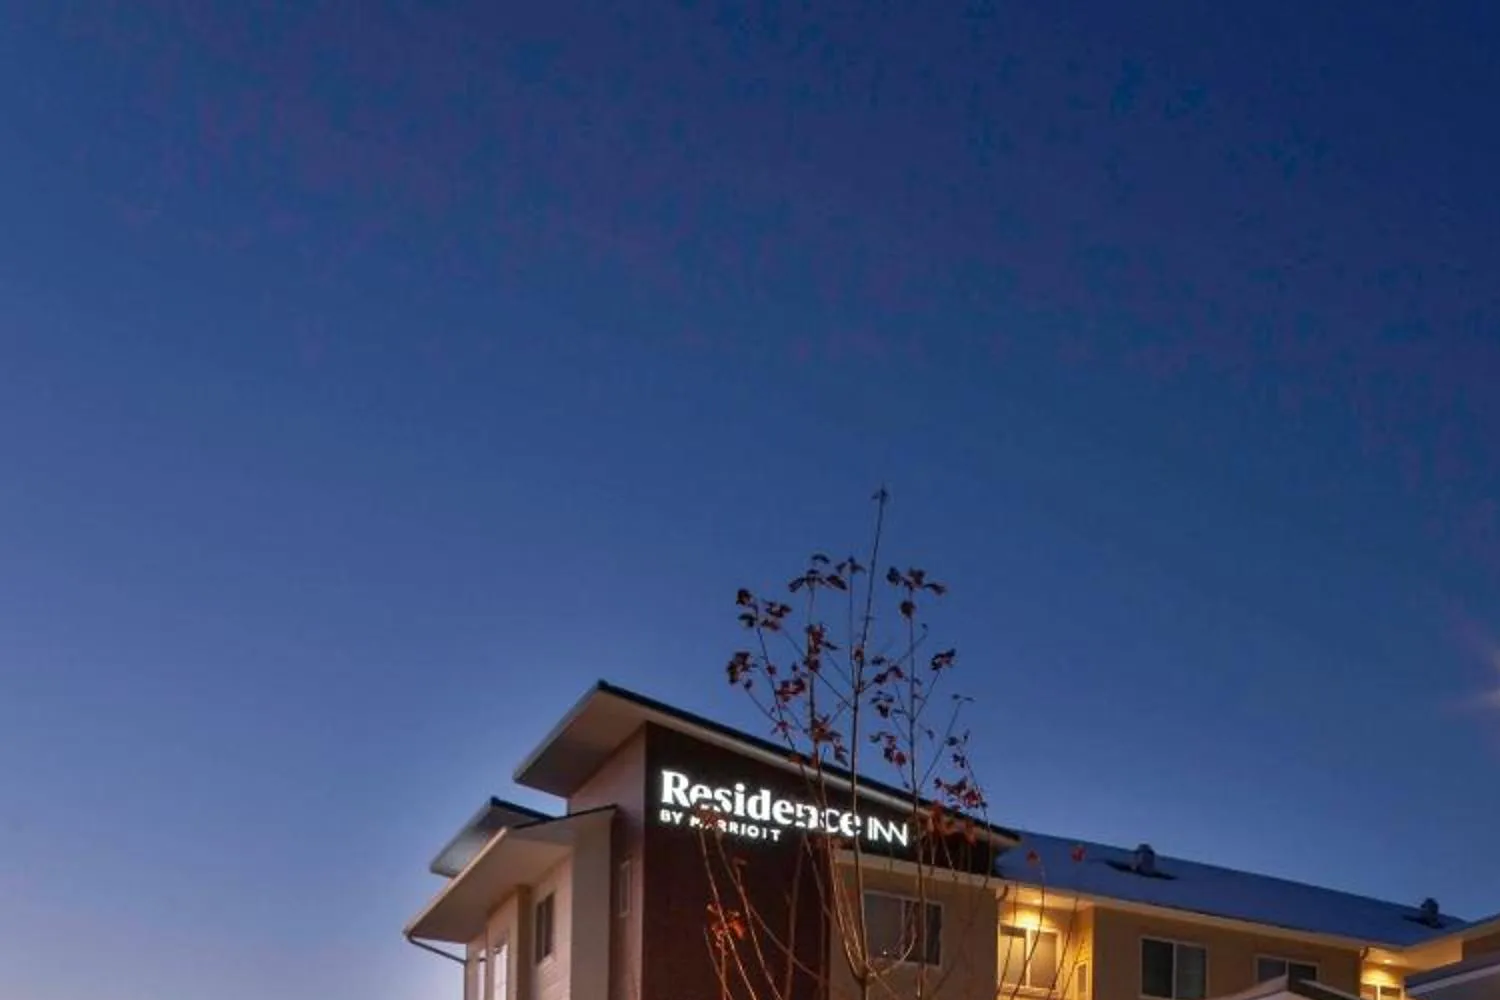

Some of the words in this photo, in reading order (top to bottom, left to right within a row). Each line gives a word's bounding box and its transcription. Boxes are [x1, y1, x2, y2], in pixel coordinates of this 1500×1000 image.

[659, 808, 684, 825] BY
[689, 815, 782, 842] MRRIOTT
[660, 769, 862, 838] Residence
[867, 815, 909, 847] INN
